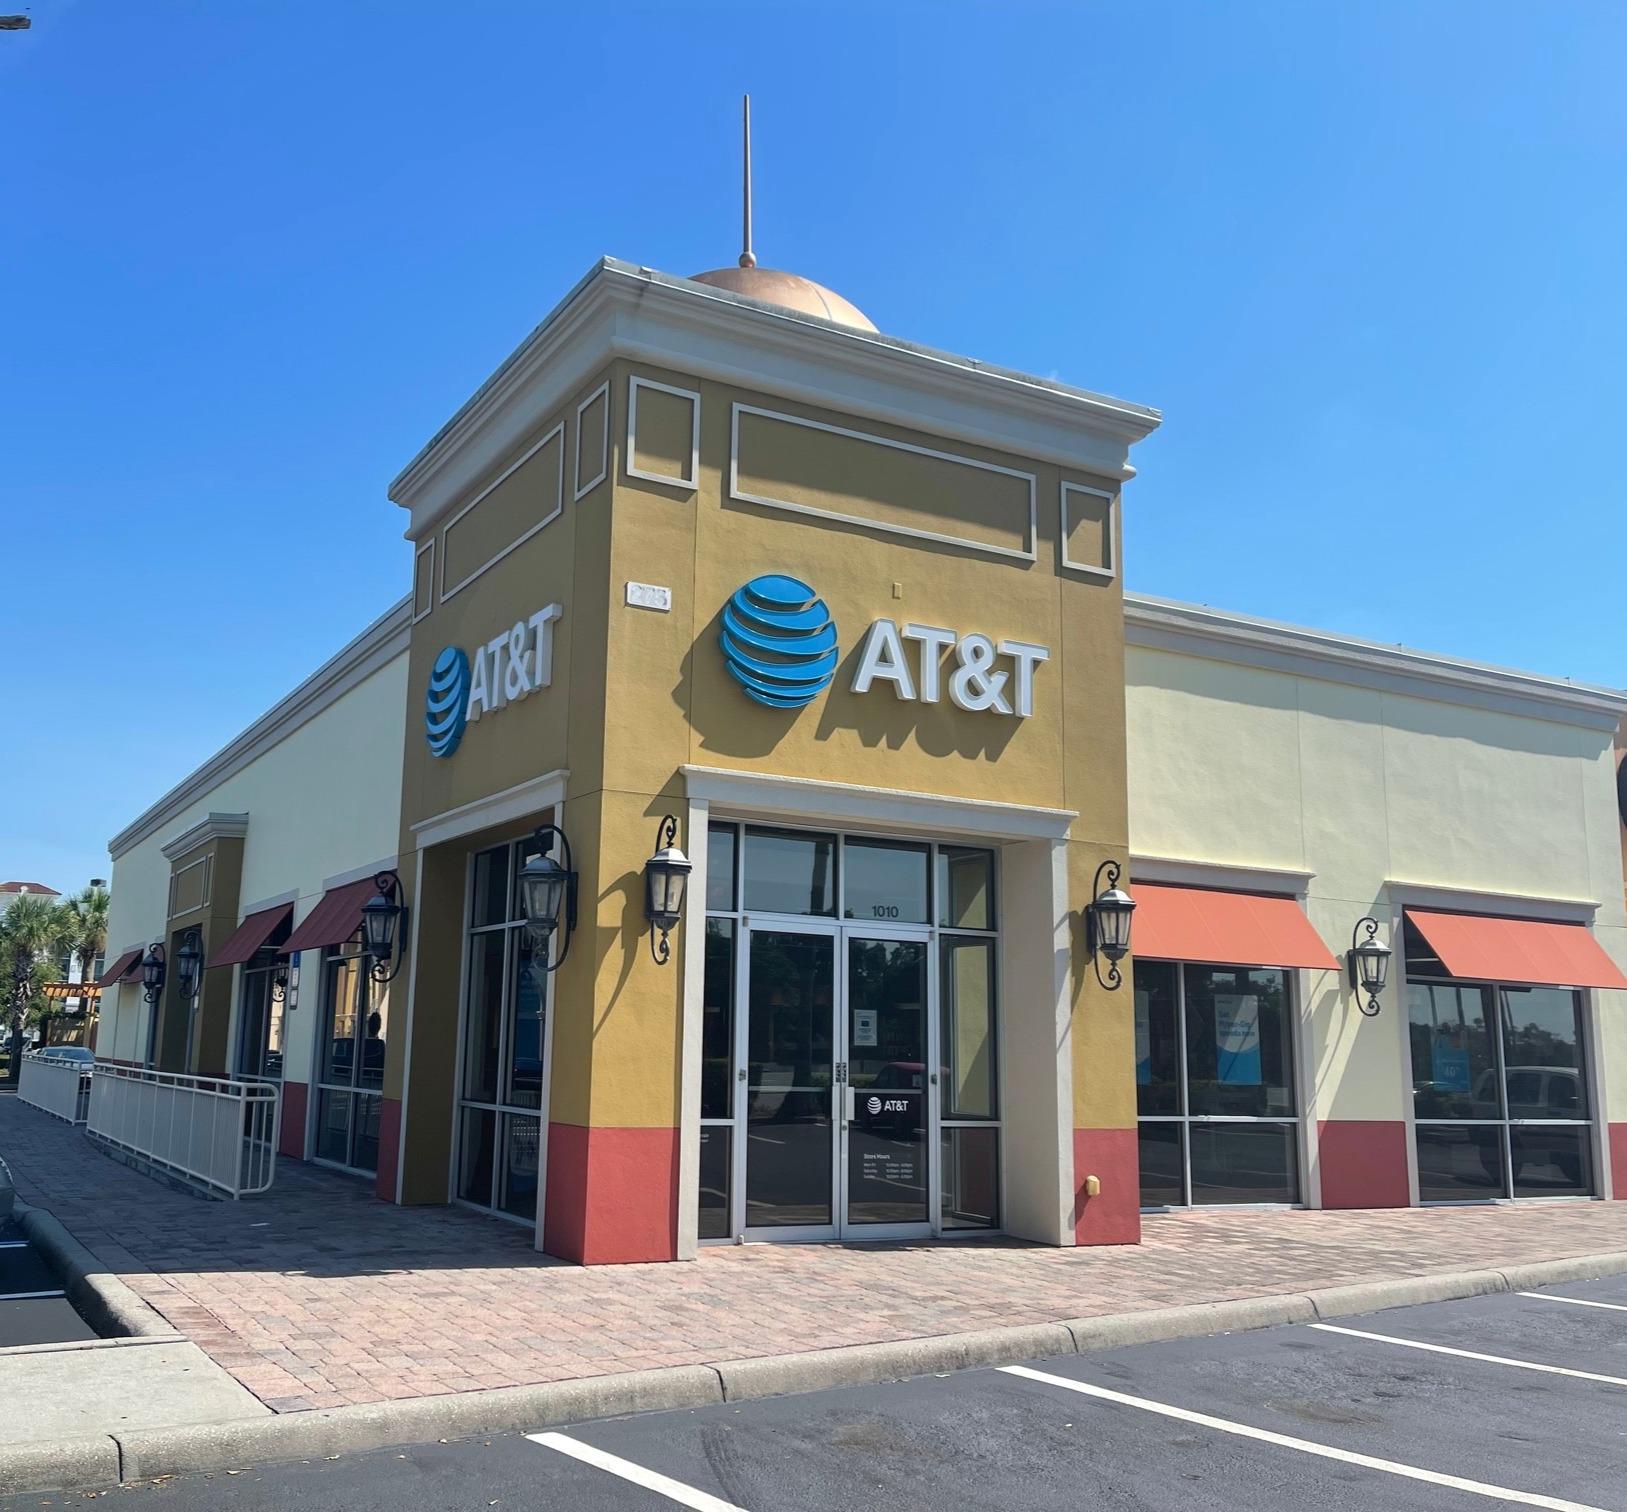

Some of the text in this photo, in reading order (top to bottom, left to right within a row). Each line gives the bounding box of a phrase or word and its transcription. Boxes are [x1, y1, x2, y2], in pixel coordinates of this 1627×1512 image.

[465, 603, 562, 722] AT&T
[851, 617, 1050, 719] AT&T
[872, 905, 899, 918] 1010
[884, 1100, 909, 1112] AT&T
